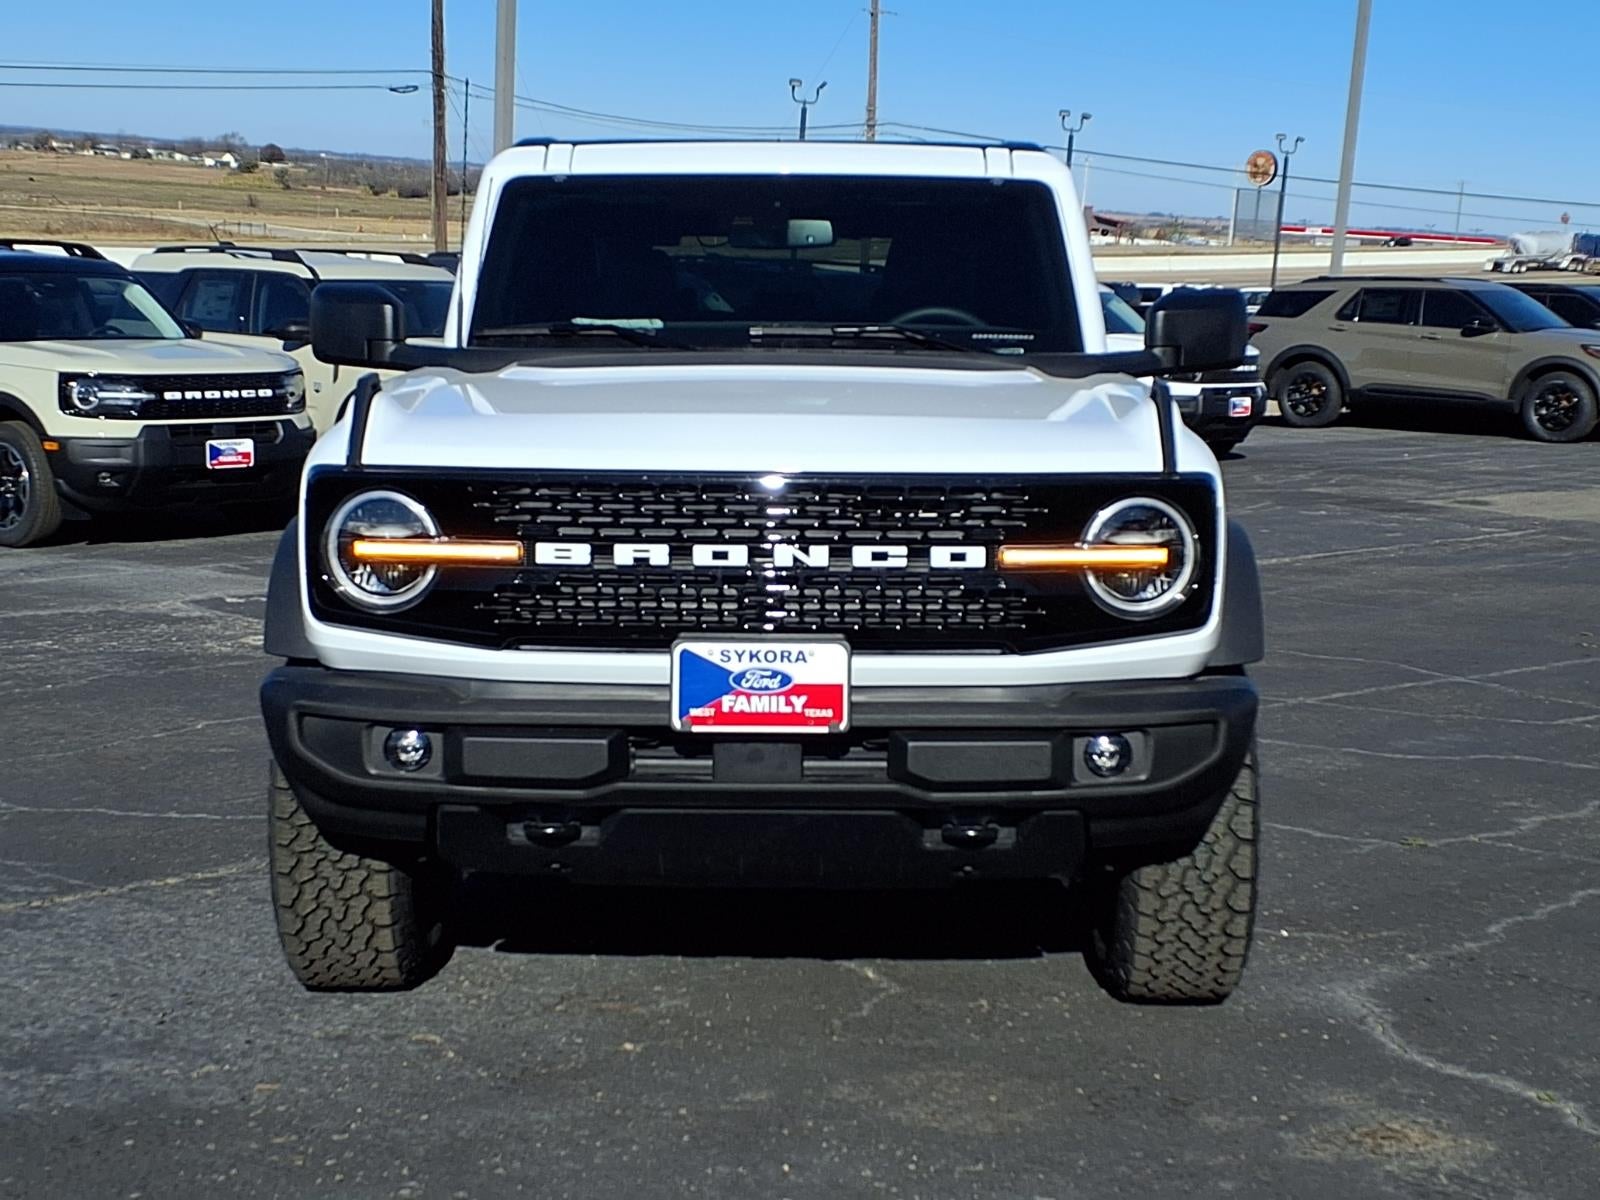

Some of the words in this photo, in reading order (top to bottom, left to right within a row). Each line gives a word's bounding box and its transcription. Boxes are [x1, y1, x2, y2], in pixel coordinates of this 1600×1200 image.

[163, 389, 273, 400] BRONCO
[534, 542, 987, 568] BRONCO
[720, 649, 808, 663] SYKORA
[741, 669, 782, 689] Ford
[721, 694, 808, 713] FAMILY
[804, 708, 834, 718] TEXAS
